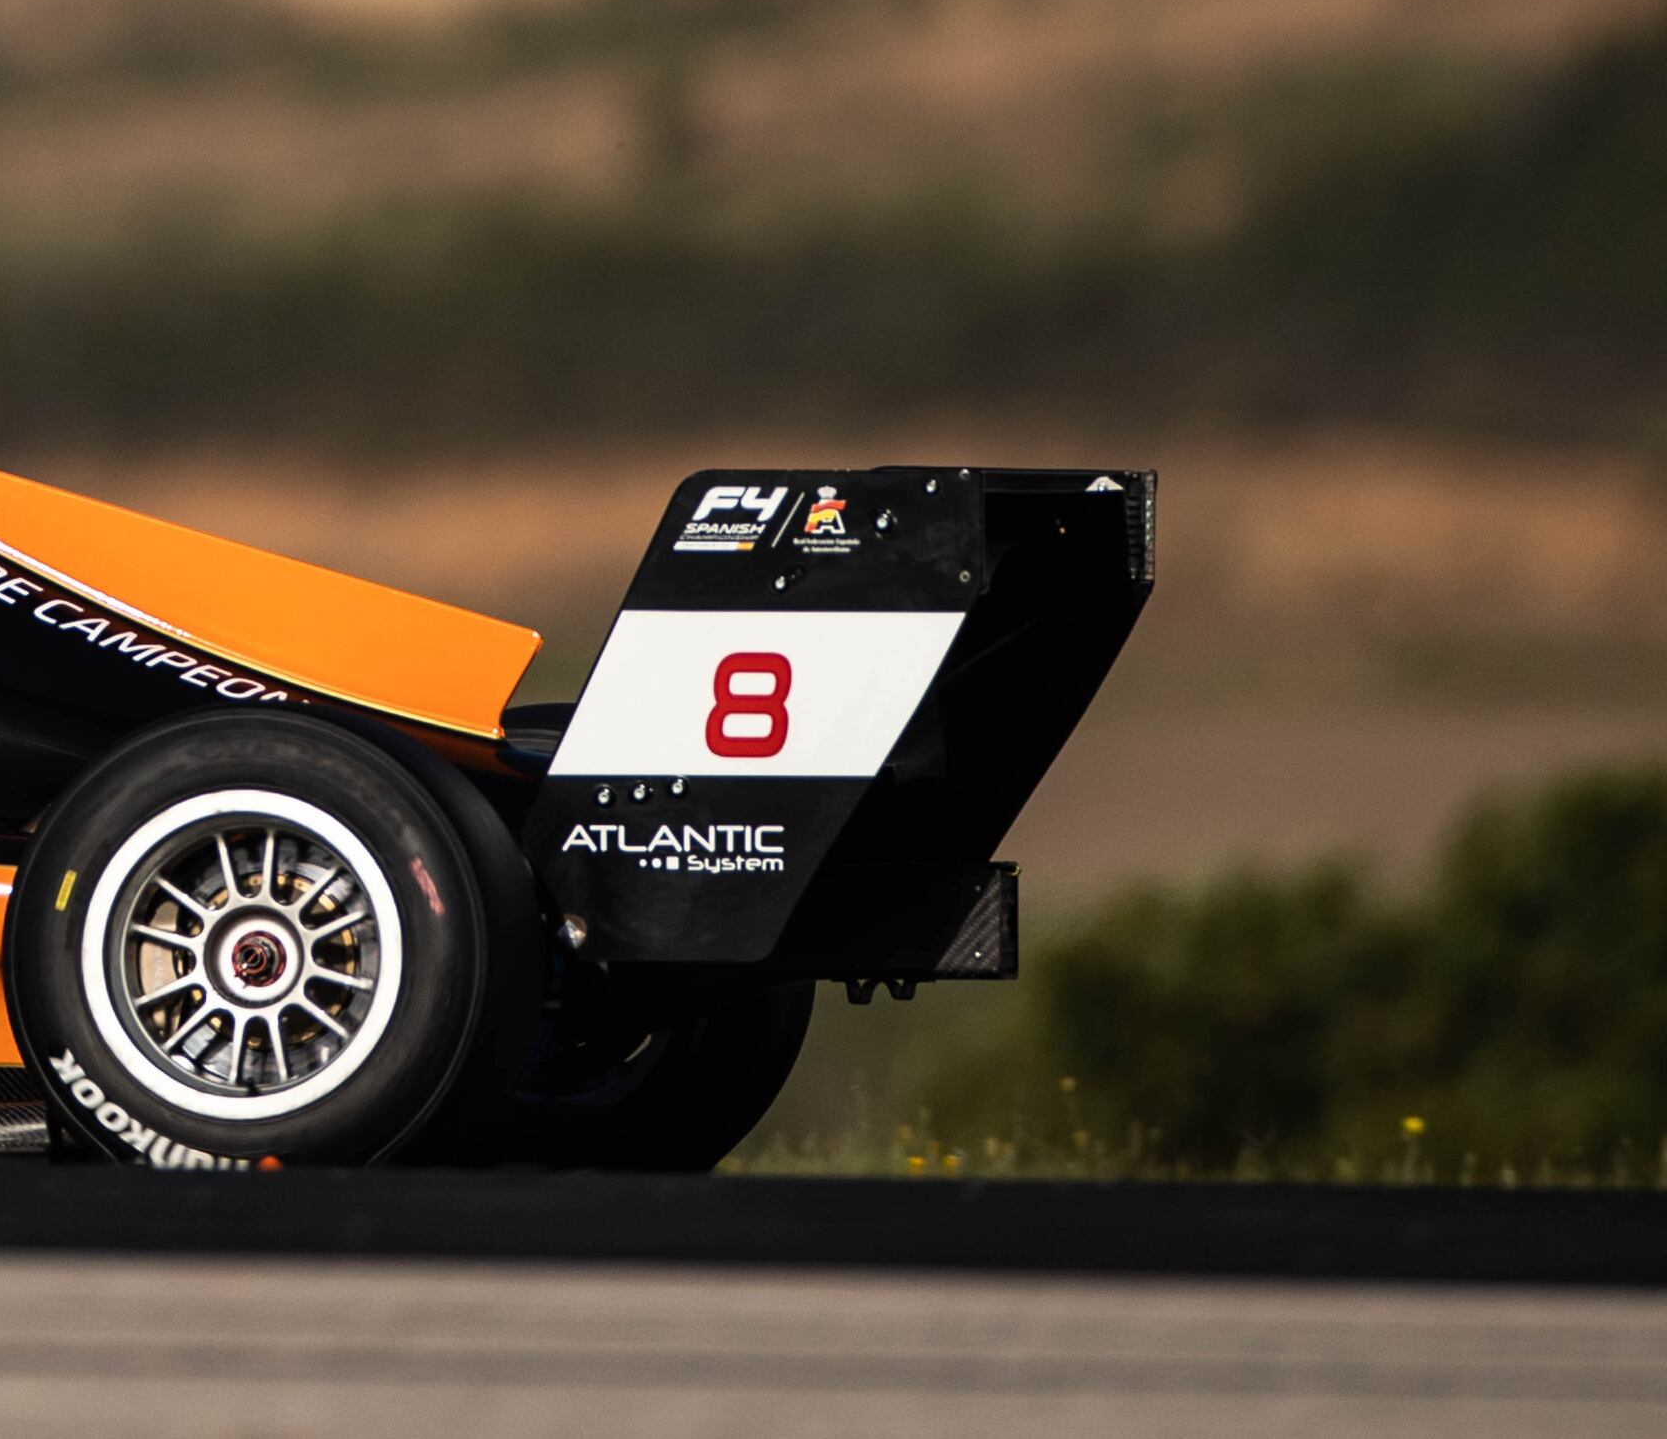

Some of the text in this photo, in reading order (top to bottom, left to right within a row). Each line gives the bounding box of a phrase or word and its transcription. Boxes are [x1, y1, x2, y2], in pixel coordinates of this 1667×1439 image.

[692, 486, 789, 522] F4
[684, 522, 767, 535] SPANISH
[705, 652, 792, 758] 8
[562, 825, 785, 853] ATLANTIC
[686, 854, 784, 874] System
